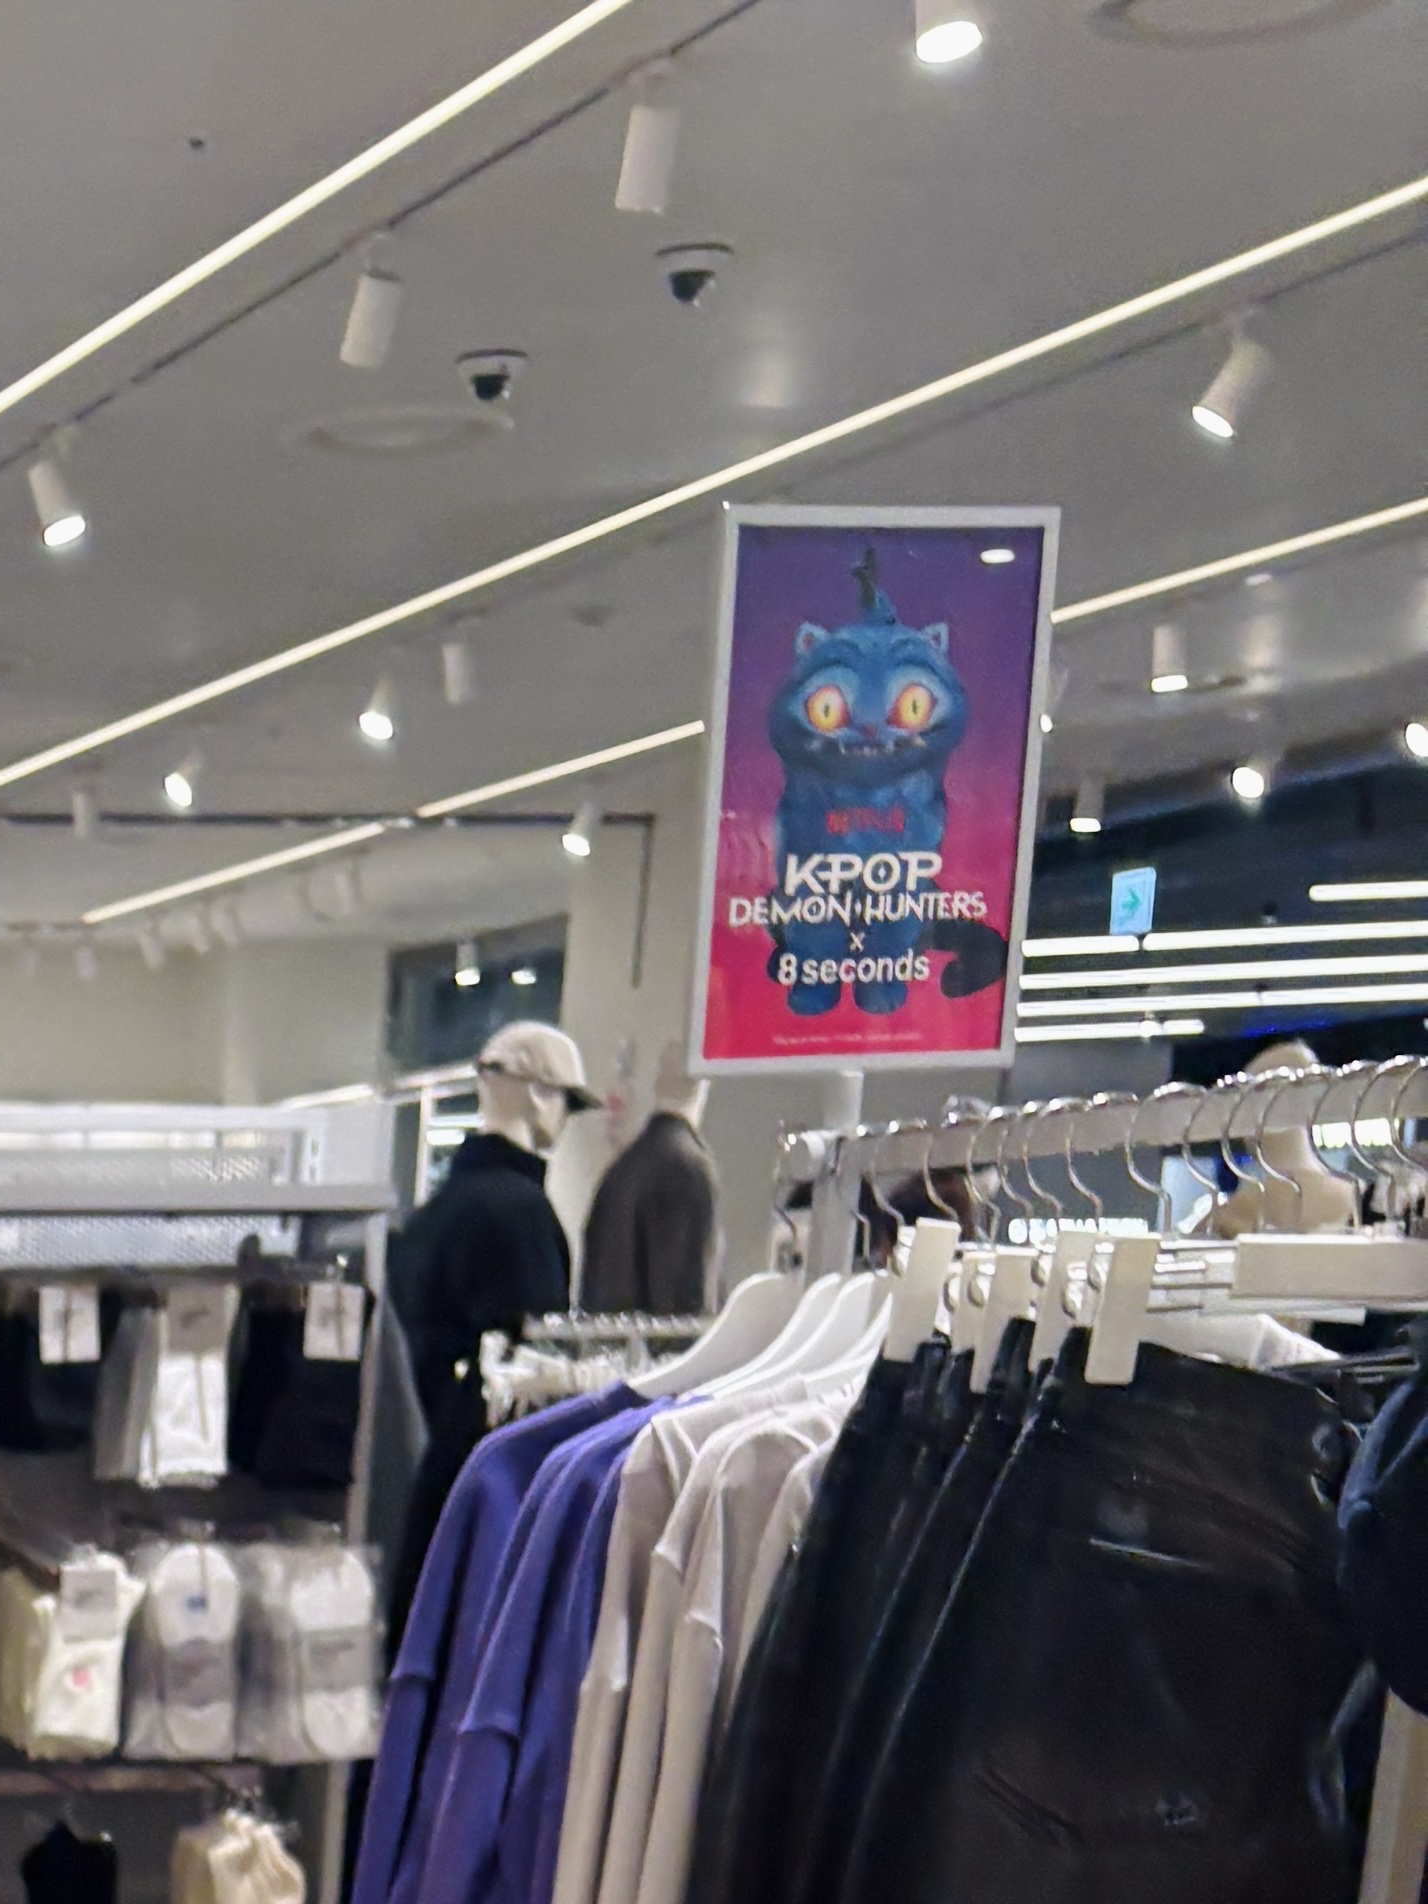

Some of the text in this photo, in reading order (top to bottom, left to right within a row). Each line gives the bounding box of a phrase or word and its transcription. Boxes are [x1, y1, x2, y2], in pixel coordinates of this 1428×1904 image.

[784, 850, 943, 896] KPOP
[729, 890, 989, 928] DEMON HUNTERS
[776, 947, 931, 986] 8 seconds
